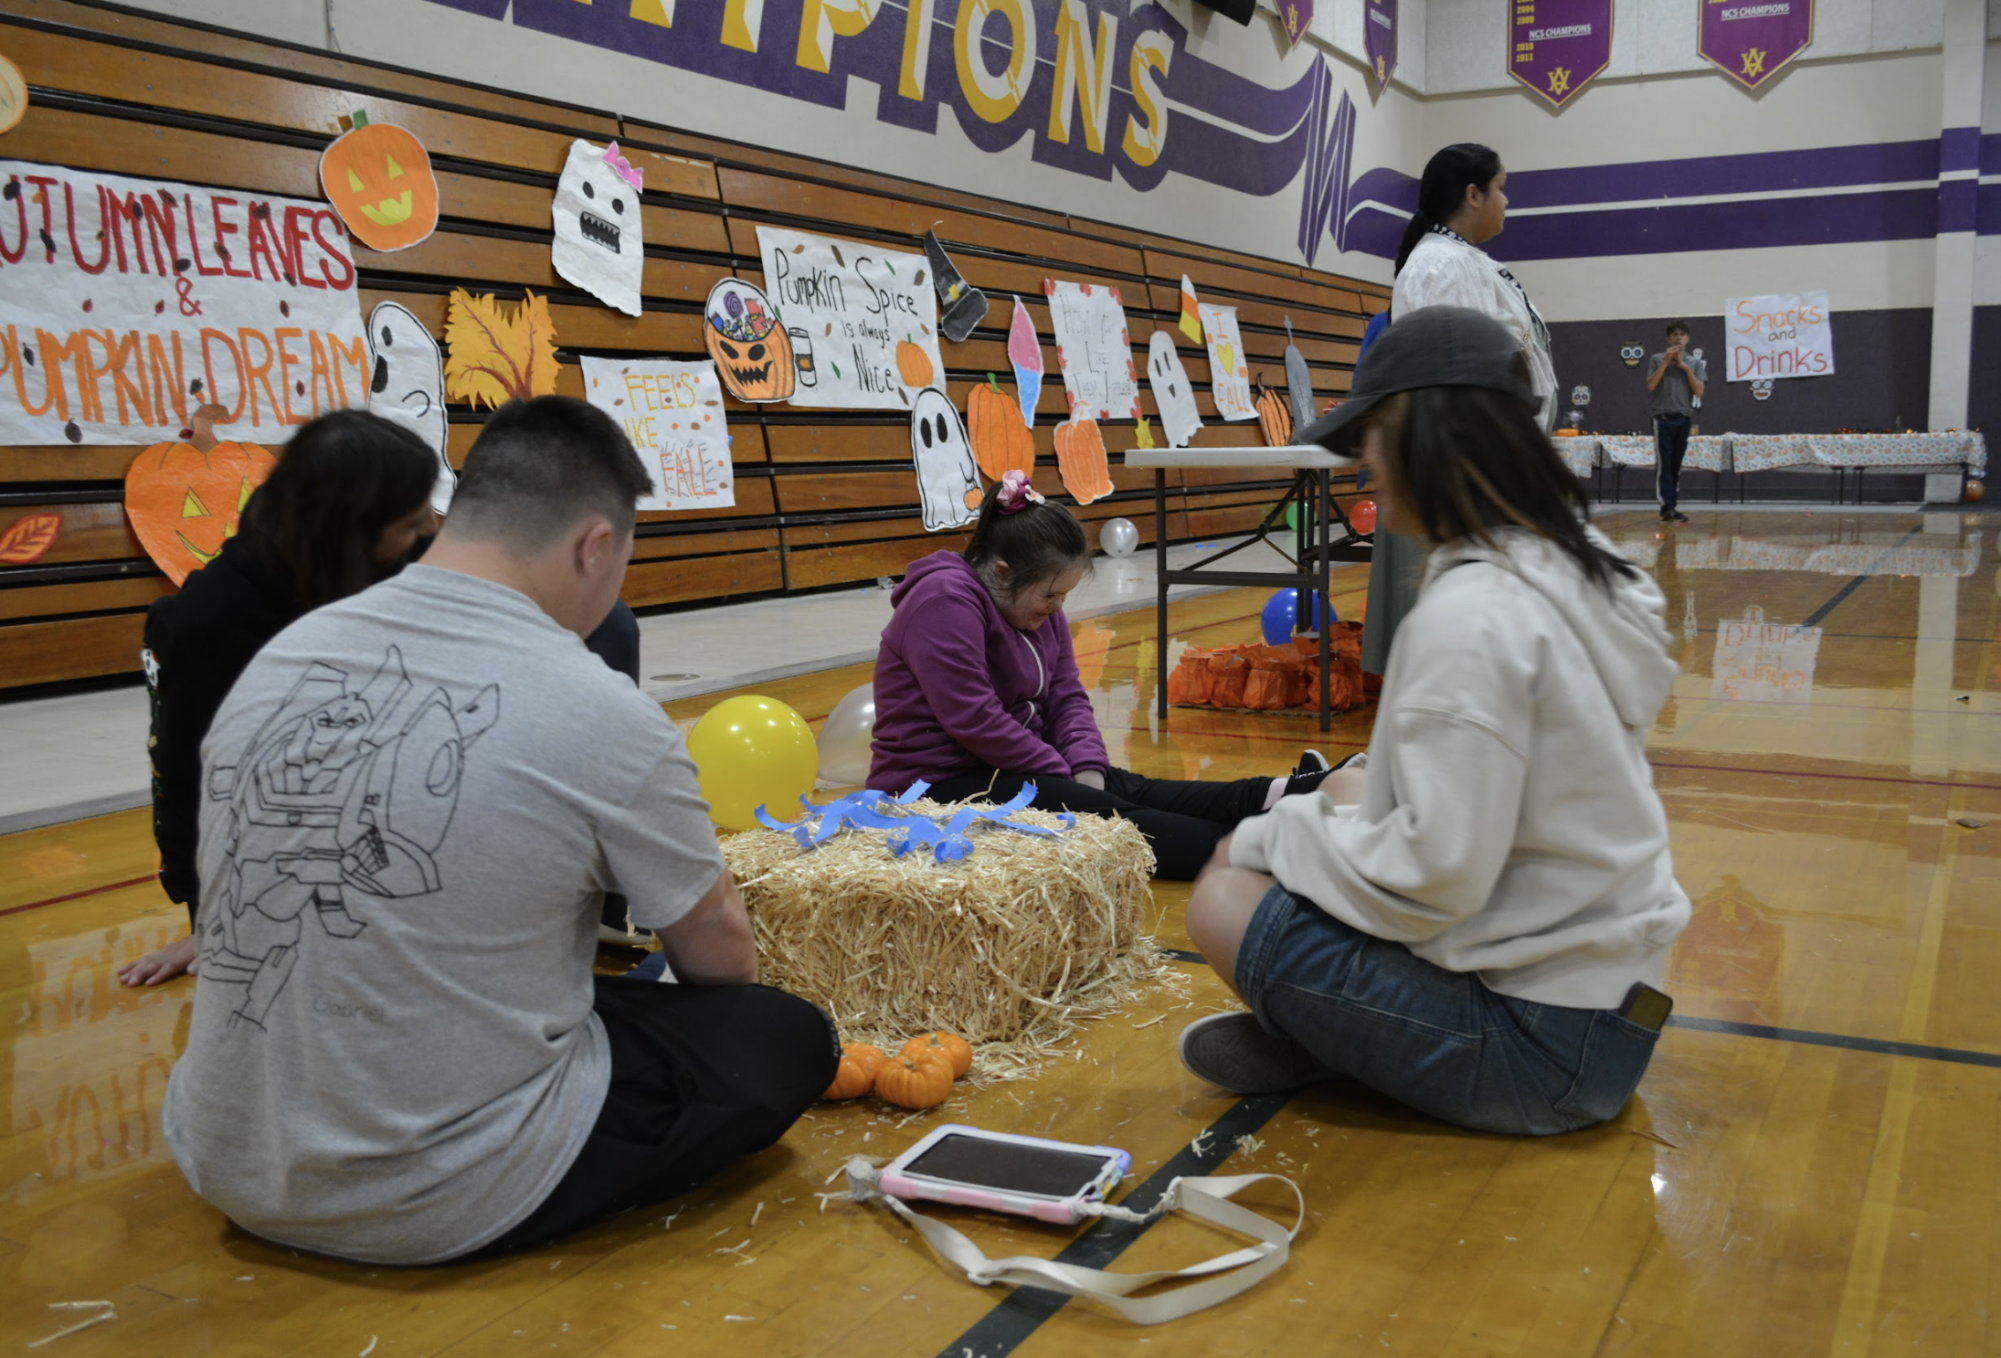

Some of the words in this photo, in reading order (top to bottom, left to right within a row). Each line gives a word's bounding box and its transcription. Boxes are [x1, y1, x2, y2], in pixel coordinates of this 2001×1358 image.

[1721, 9, 1738, 19] NCS
[1739, 2, 1790, 17] CHAMPIONS
[1529, 29, 1544, 39] NCS
[1545, 23, 1592, 38] CHAMPIONS
[0, 174, 182, 277] UTUMN
[184, 193, 354, 291] LEAVES
[175, 276, 203, 317] &
[855, 256, 919, 327] Spice
[841, 320, 855, 339] is
[858, 318, 891, 349] always
[1211, 311, 1230, 339] I
[1733, 299, 1823, 335] Snacks
[1767, 327, 1797, 342] and
[199, 326, 370, 427] DREAM
[851, 342, 895, 394] Nice
[1734, 345, 1828, 379] Drinks
[624, 372, 697, 412] FEELS
[1217, 382, 1251, 417] FALL
[623, 416, 659, 449] IKE
[660, 446, 718, 498] FALL
